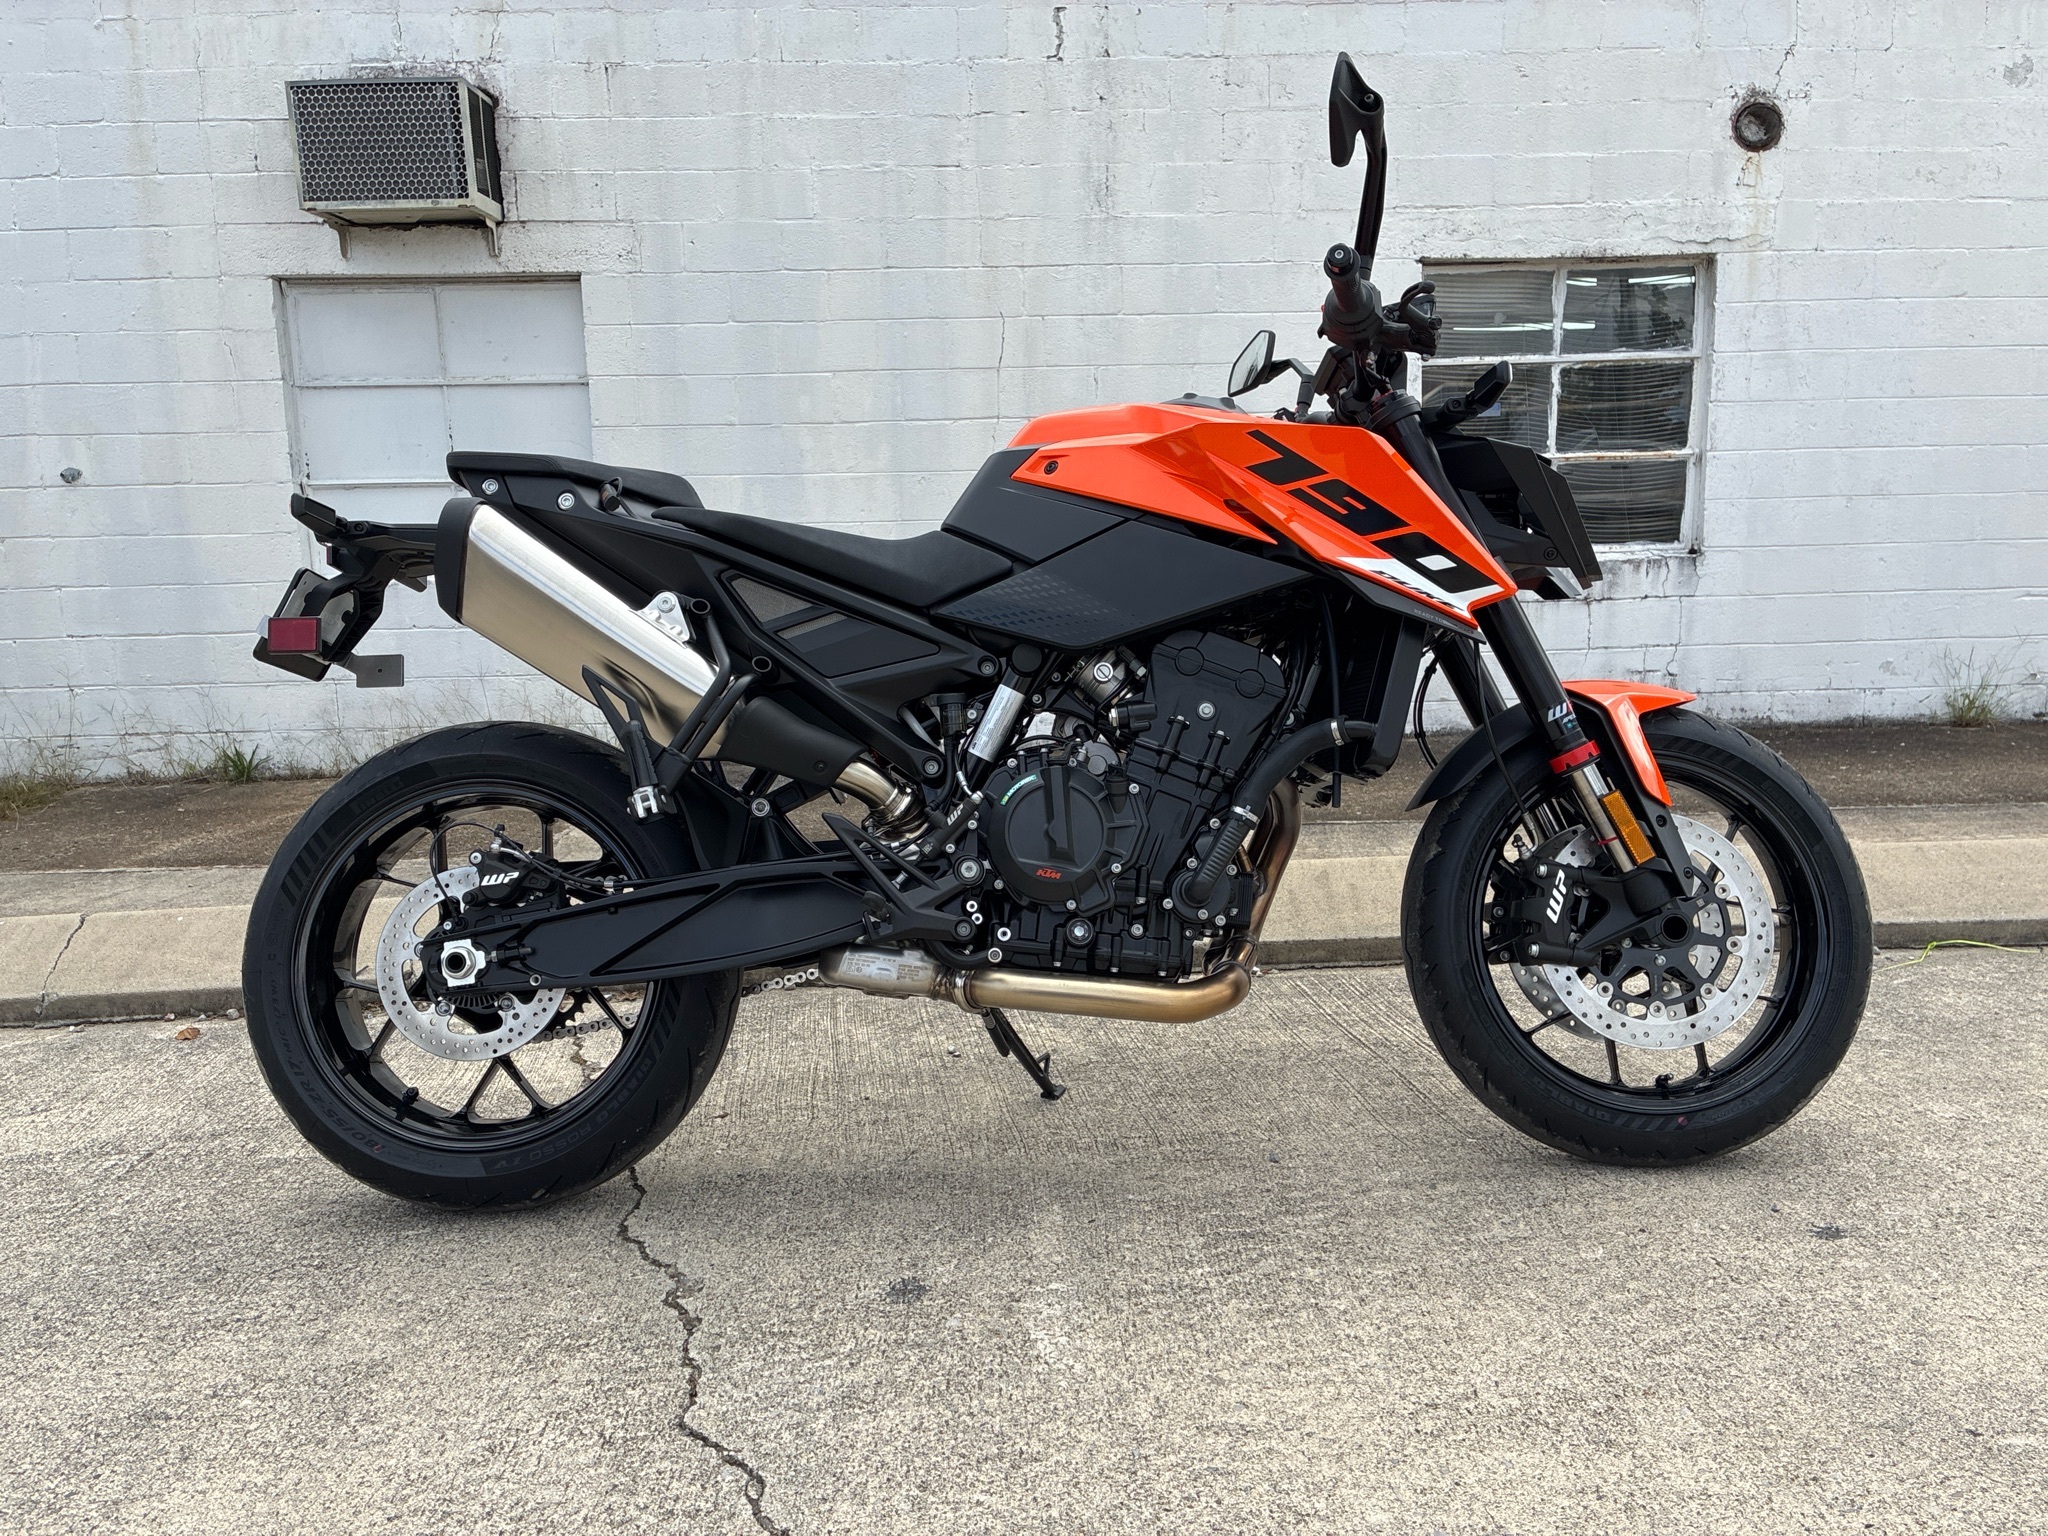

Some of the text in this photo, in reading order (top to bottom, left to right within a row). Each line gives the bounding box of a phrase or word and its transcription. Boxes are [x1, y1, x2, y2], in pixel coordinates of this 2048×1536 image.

[1244, 429, 1500, 594] 790
[1368, 569, 1465, 612] DUKE
[946, 803, 964, 826] WP
[480, 871, 520, 887] WP
[1036, 868, 1062, 880] KTM
[1546, 868, 1566, 924] WP
